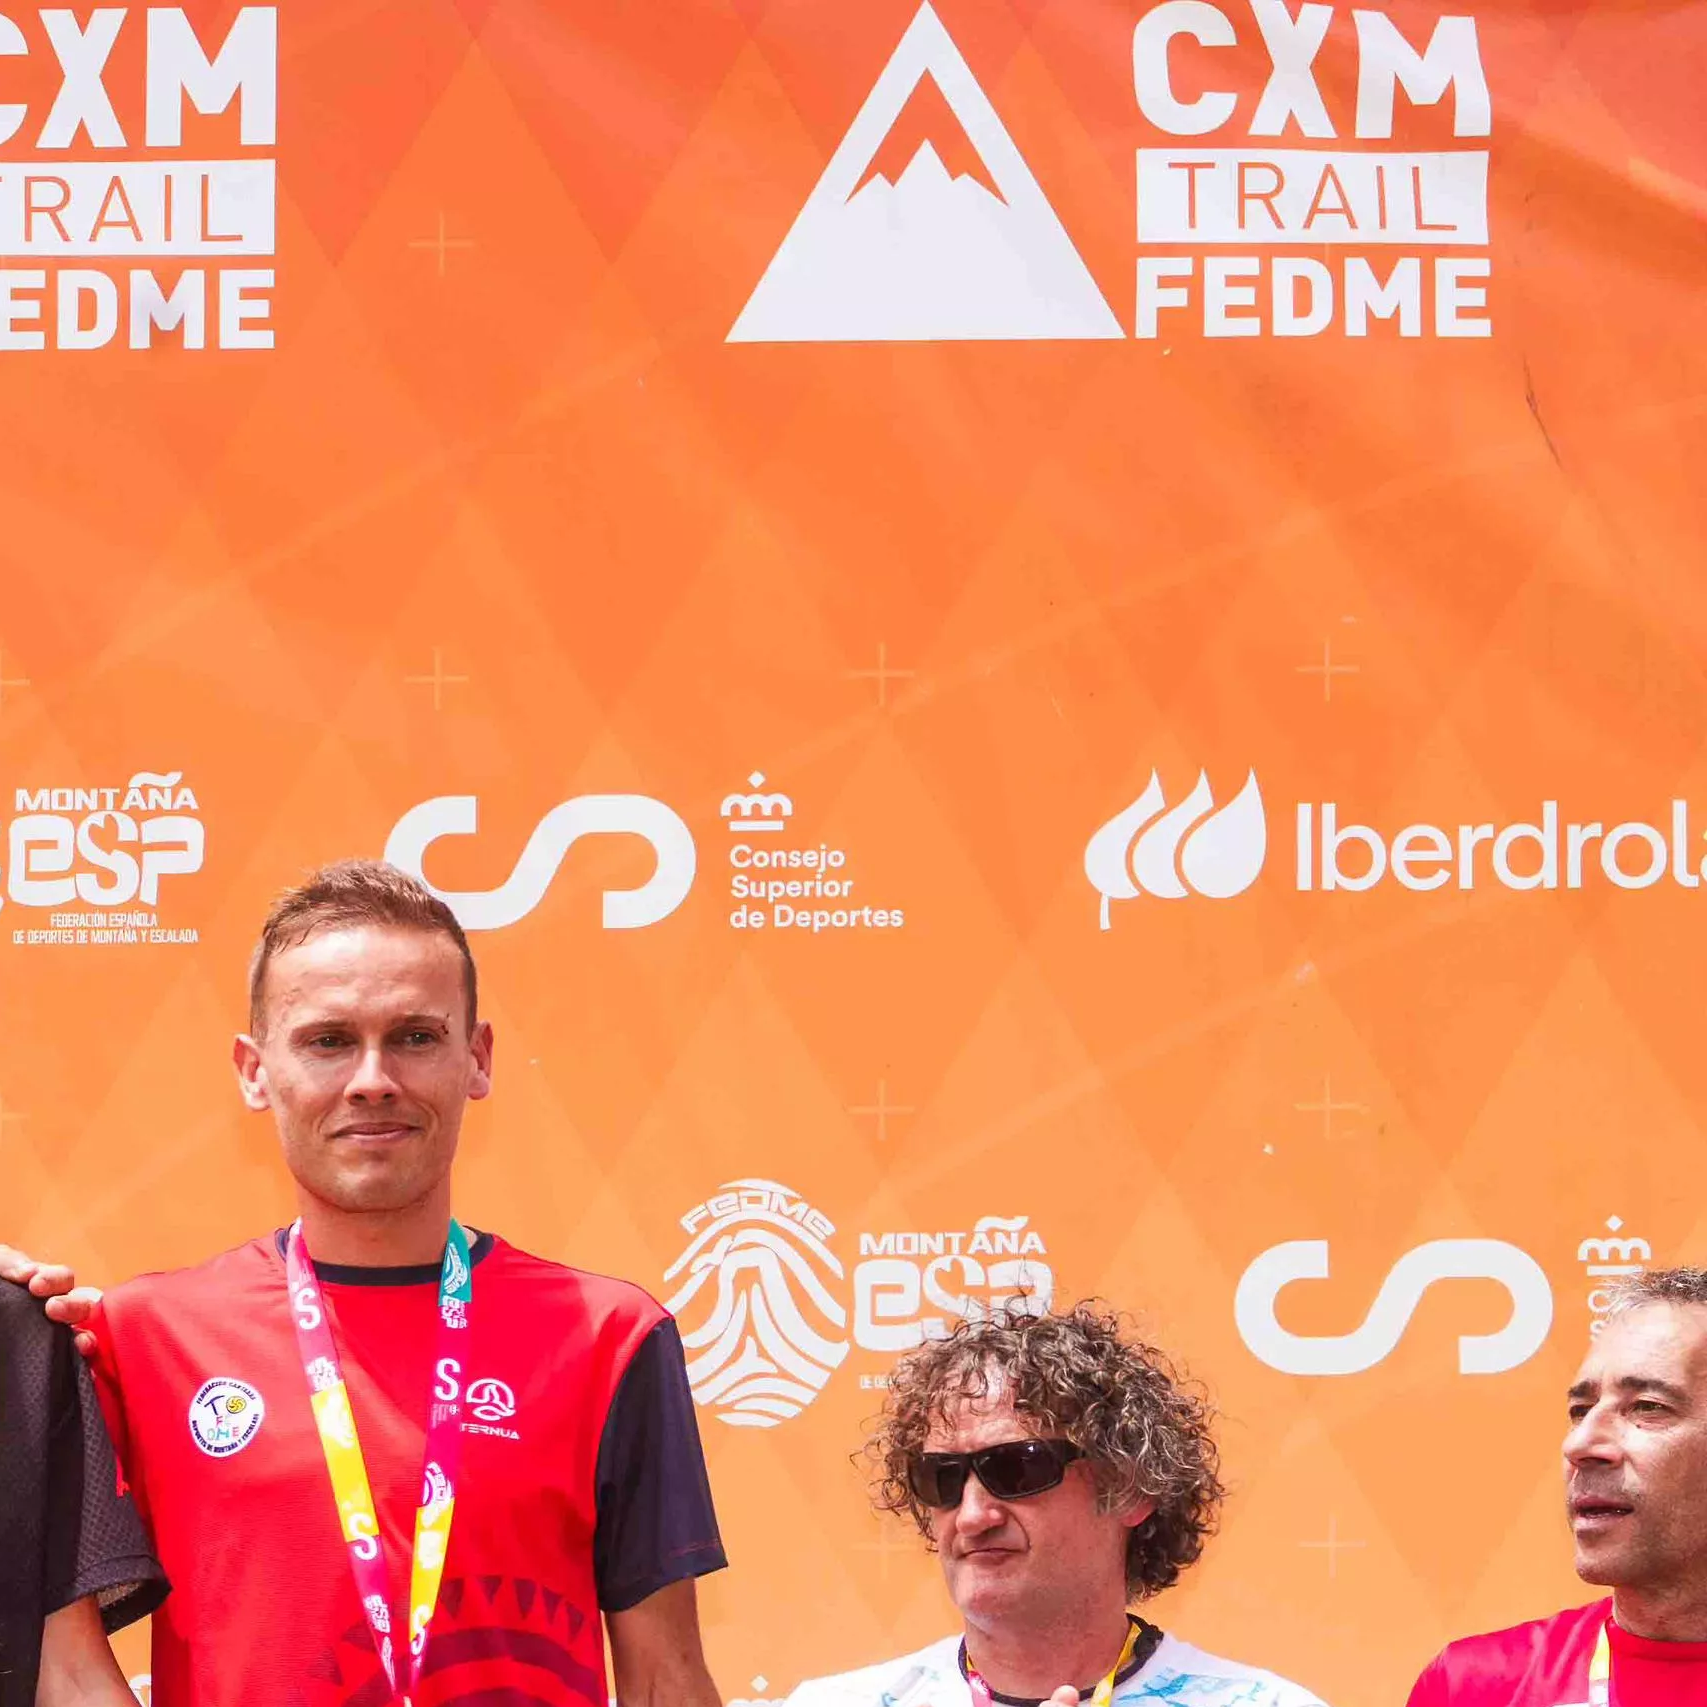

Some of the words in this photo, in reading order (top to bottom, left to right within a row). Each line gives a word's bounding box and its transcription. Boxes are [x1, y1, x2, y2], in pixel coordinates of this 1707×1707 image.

[1132, 0, 1492, 139] CXM
[1166, 161, 1459, 232] TRAIL
[1135, 256, 1492, 339] FEDME
[15, 771, 199, 811] MONTAÑA
[730, 844, 846, 874] Consejo
[1296, 799, 1707, 892] Iberdrol
[730, 873, 854, 903] Superior
[13, 930, 25, 944] DE
[28, 930, 73, 945] DEPORTES
[76, 930, 88, 944] DE
[90, 928, 139, 944] MONTAÑA
[150, 929, 199, 944] ESCALADA
[50, 911, 107, 929] FEDERACIÓN
[109, 911, 158, 929] ESPAÑOLA
[729, 904, 765, 929] de
[773, 903, 904, 933] Deportes
[859, 1216, 1046, 1256] MONTAÑA
